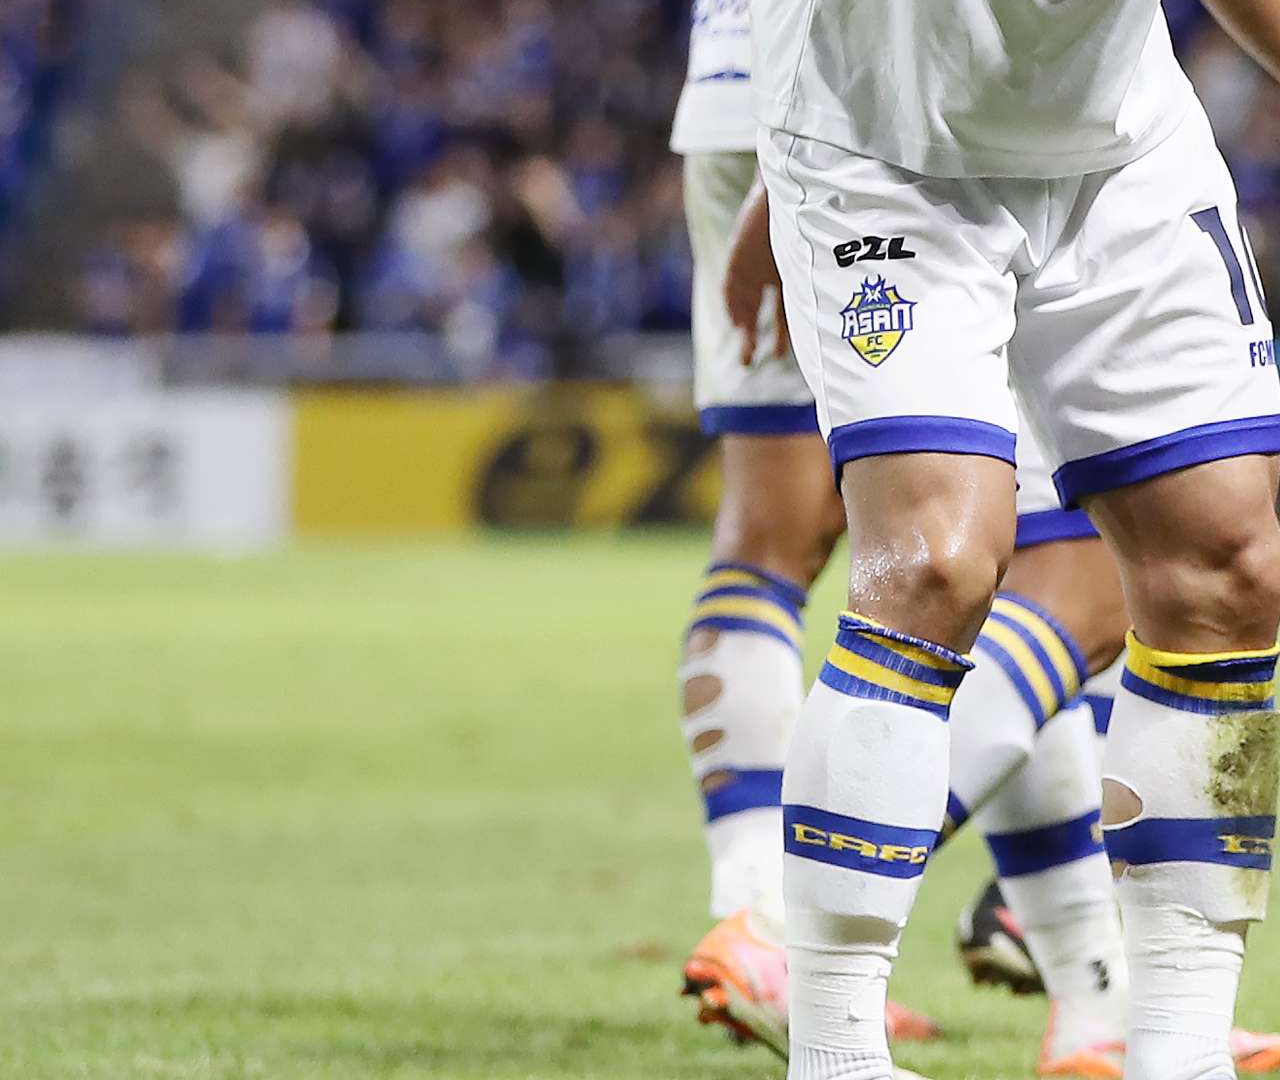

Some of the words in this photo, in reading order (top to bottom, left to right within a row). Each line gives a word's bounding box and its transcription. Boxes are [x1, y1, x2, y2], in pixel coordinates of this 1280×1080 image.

[842, 302, 914, 339] ASAN
[866, 334, 883, 347] FC
[791, 822, 929, 864] CAFC
